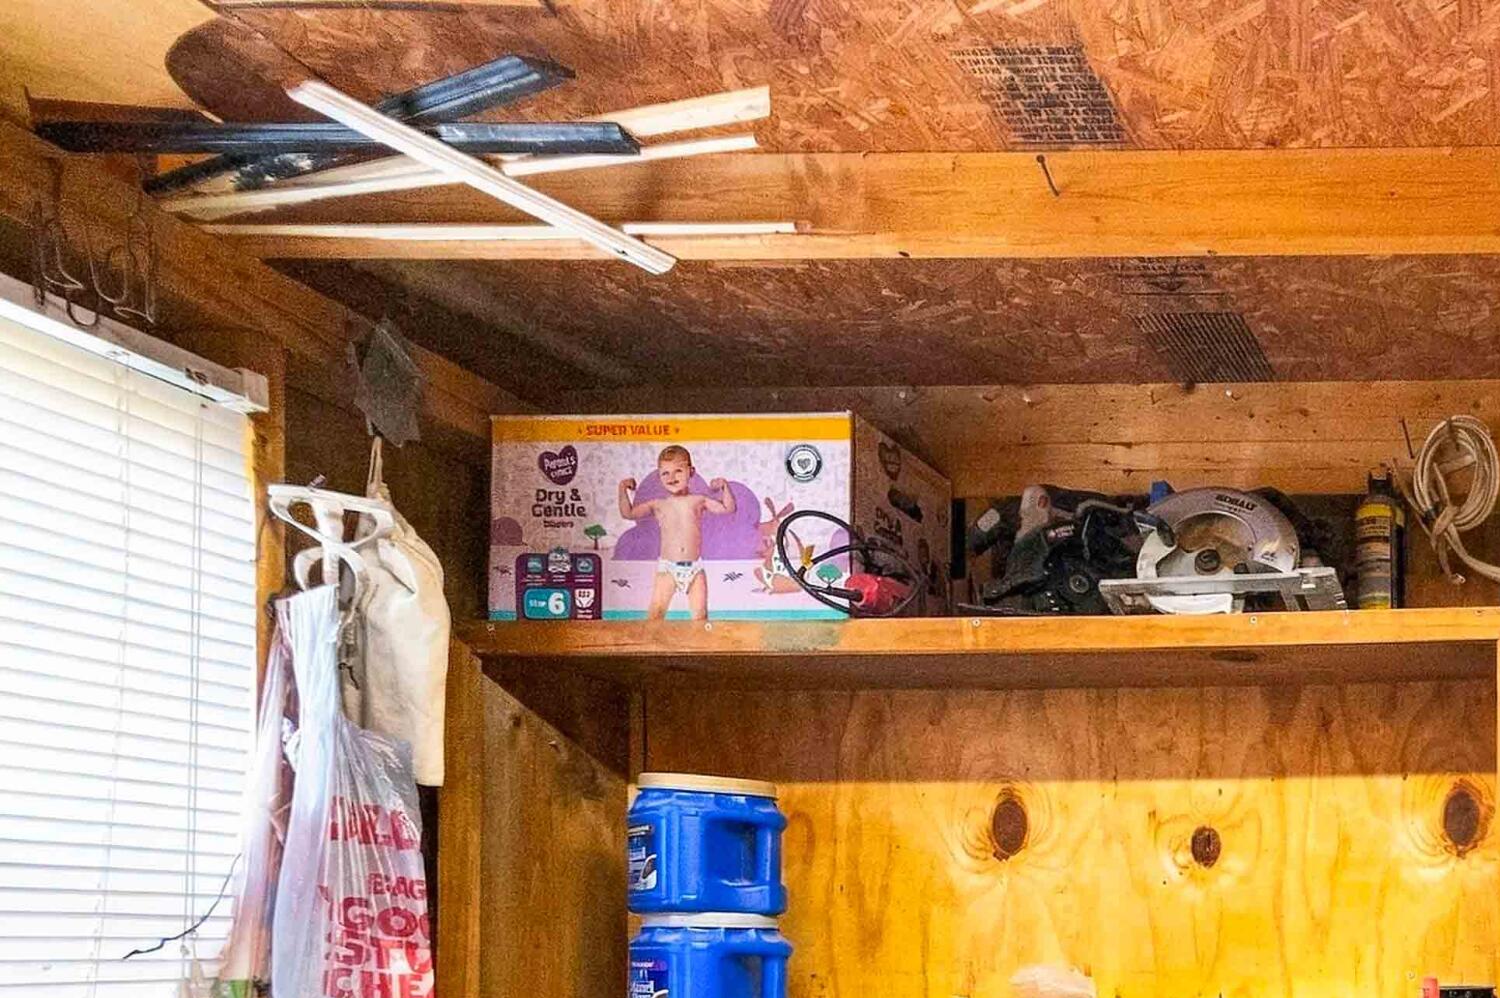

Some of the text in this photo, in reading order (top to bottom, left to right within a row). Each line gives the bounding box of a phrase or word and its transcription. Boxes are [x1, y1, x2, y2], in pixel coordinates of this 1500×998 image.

[586, 425, 670, 436] SUPER VALUE
[536, 488, 582, 504] Dry &
[531, 503, 587, 518] Gentle
[548, 592, 565, 614] 6
